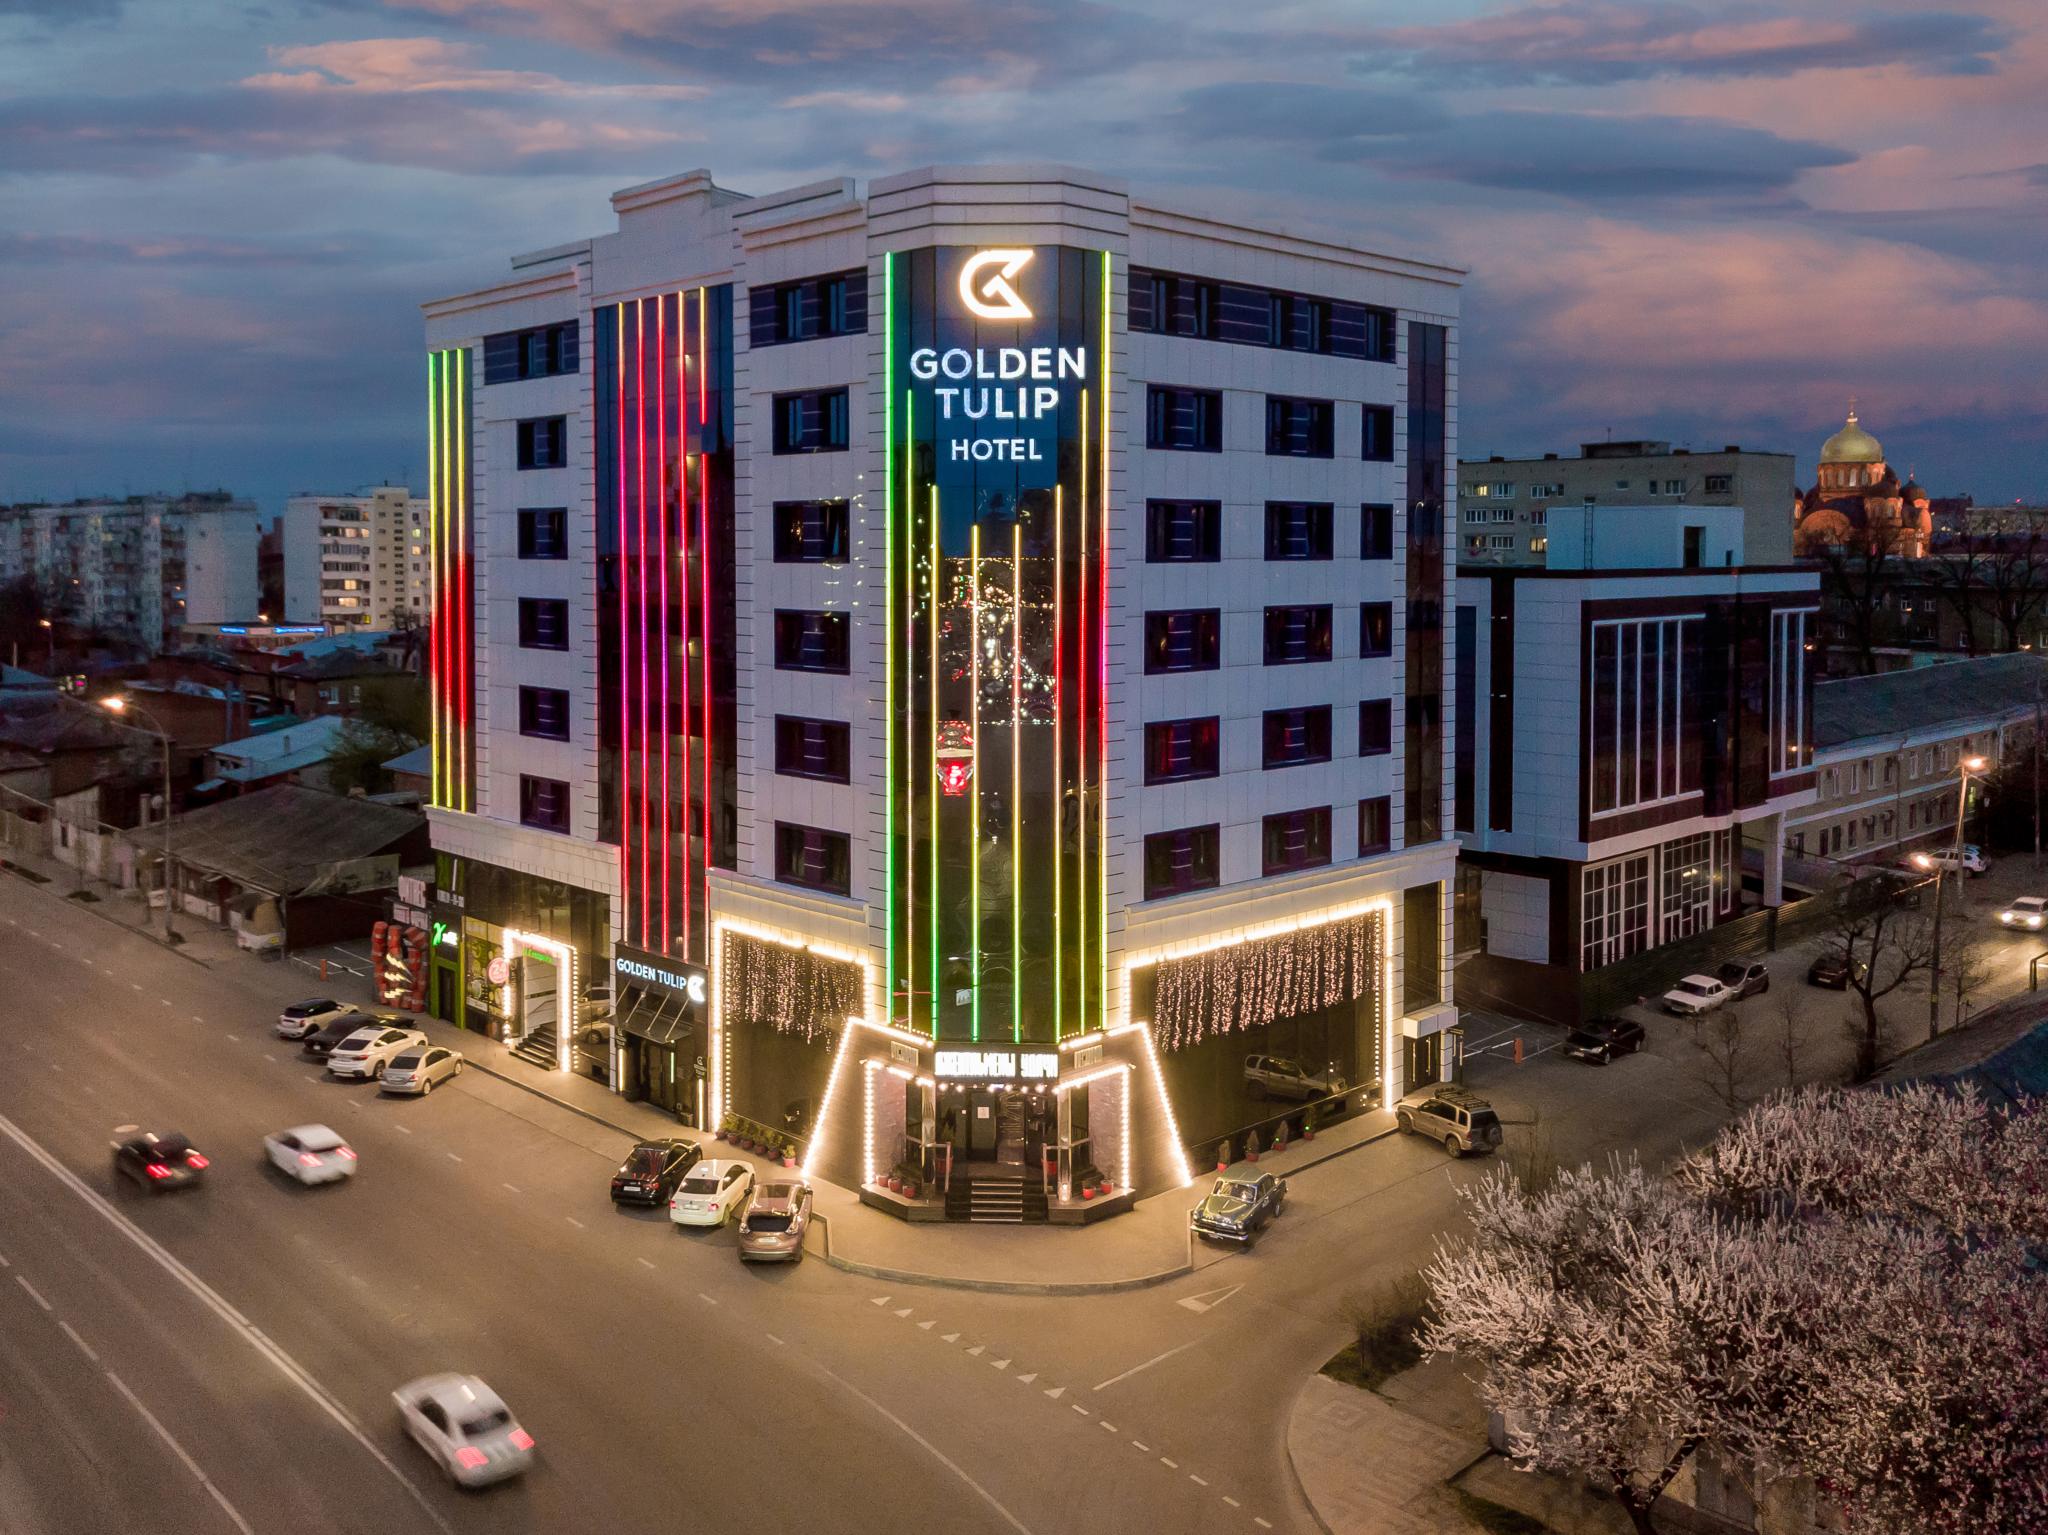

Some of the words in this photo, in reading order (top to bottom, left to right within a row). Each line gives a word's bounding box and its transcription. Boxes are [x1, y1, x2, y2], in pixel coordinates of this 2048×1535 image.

[910, 347, 1085, 380] GOLDEN
[935, 387, 1059, 419] TULIP
[951, 438, 1043, 461] HOTEL
[616, 957, 656, 981] GOLDEN
[657, 969, 687, 990] TULIP
